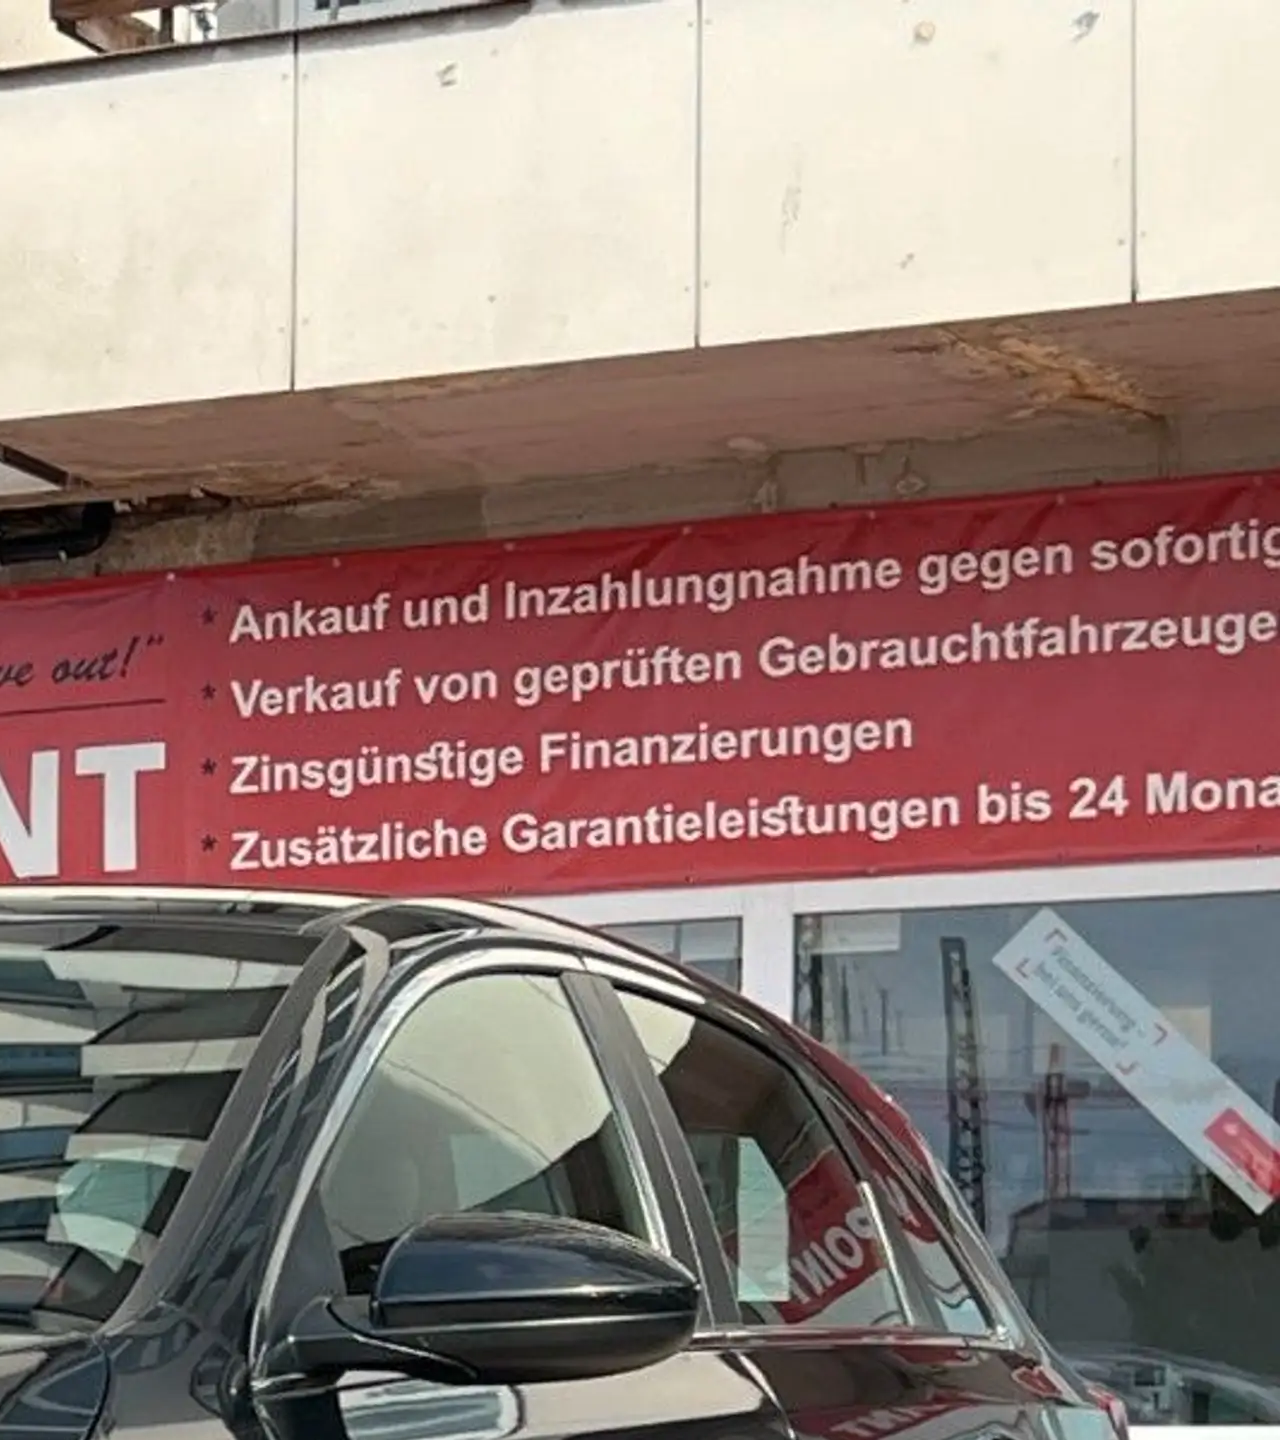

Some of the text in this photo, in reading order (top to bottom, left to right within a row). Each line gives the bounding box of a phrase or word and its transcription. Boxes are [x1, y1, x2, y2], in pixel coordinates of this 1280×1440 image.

[229, 593, 389, 642] Ankauf
[404, 584, 488, 627] und
[506, 556, 901, 619] Inzahlungnahme
[920, 542, 1072, 594] gegen
[230, 609, 1277, 717] Verkauf von geprüften Gebrauchtfahrzeuge
[230, 717, 912, 798] Zinsgünstige Finanzierungen
[230, 818, 487, 871] Zusätzliche
[502, 794, 960, 853] Garantieleistungen
[978, 781, 1052, 824] bis
[1069, 775, 1129, 819] 24
